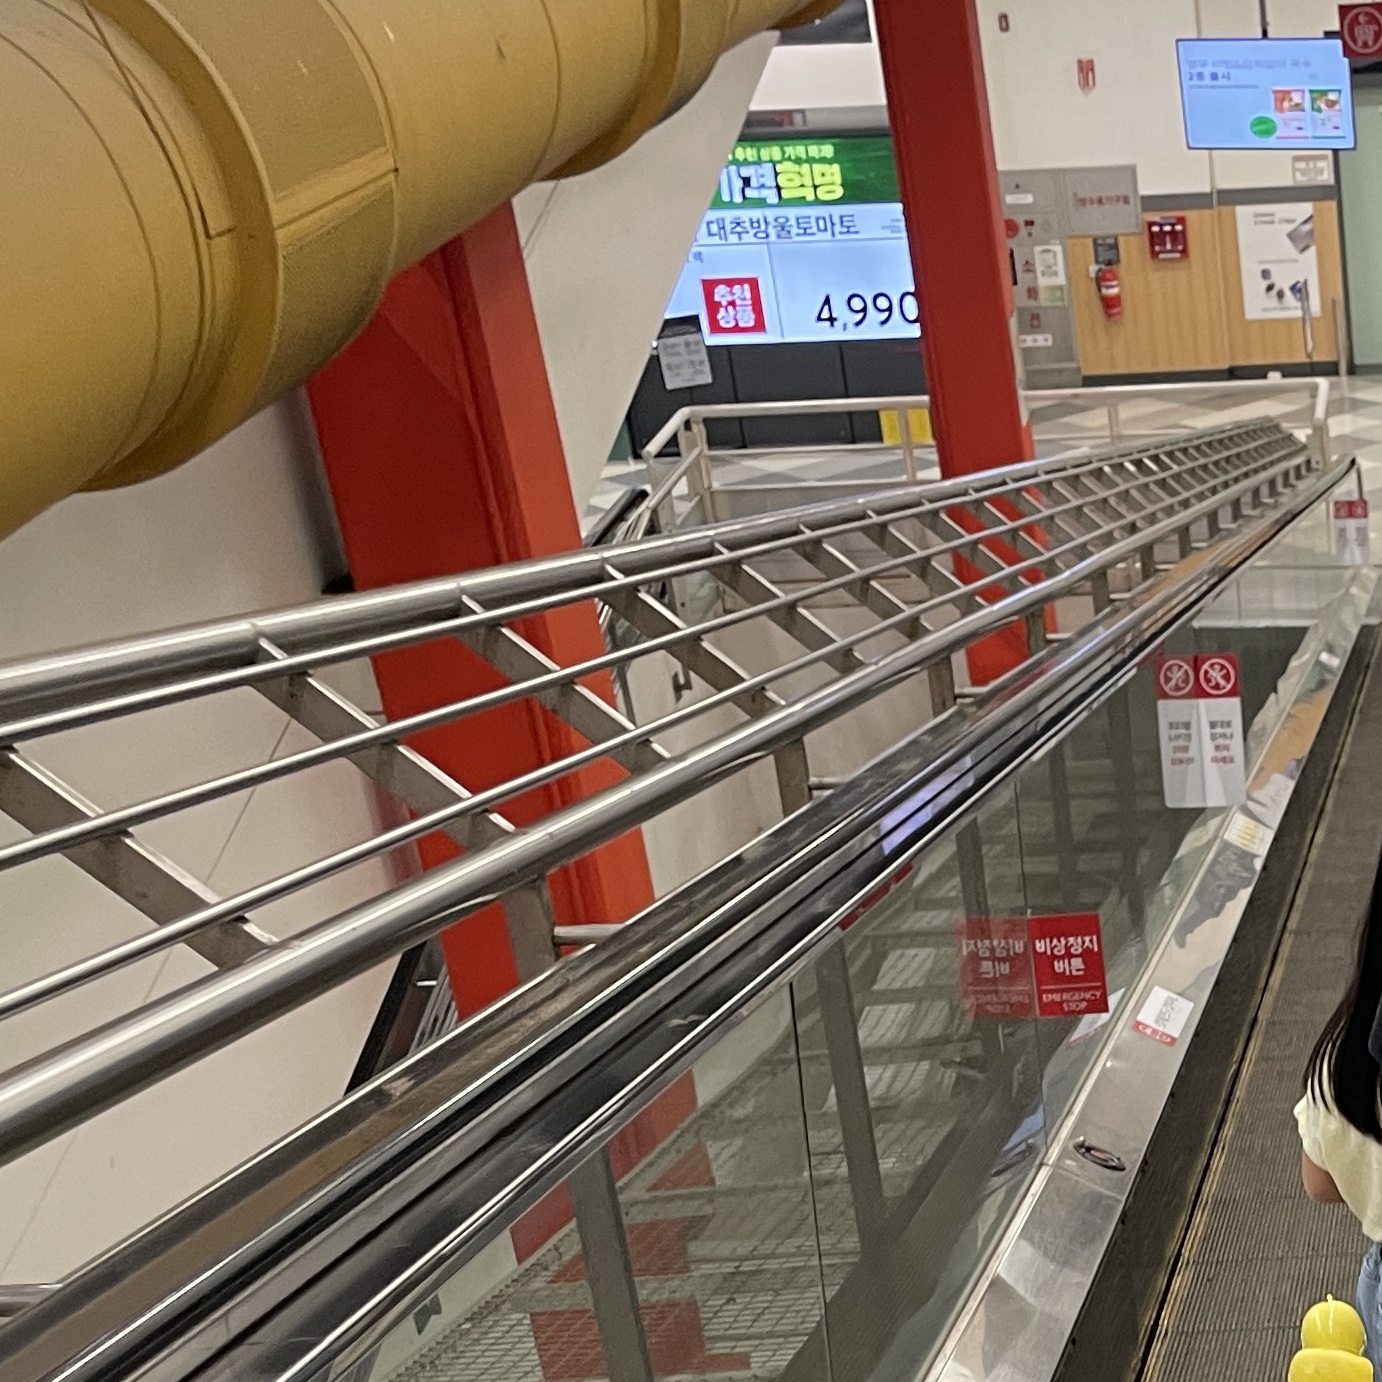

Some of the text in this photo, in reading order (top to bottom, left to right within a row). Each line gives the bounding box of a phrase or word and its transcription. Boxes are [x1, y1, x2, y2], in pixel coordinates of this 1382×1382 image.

[706, 213, 861, 242] 대추방울토마토
[815, 291, 920, 331] 4,990
[1035, 935, 1098, 956] 비상정지
[1053, 957, 1086, 976] 버튼
[1042, 989, 1101, 1003] EMERGENCY
[1062, 1002, 1088, 1012] STOP
